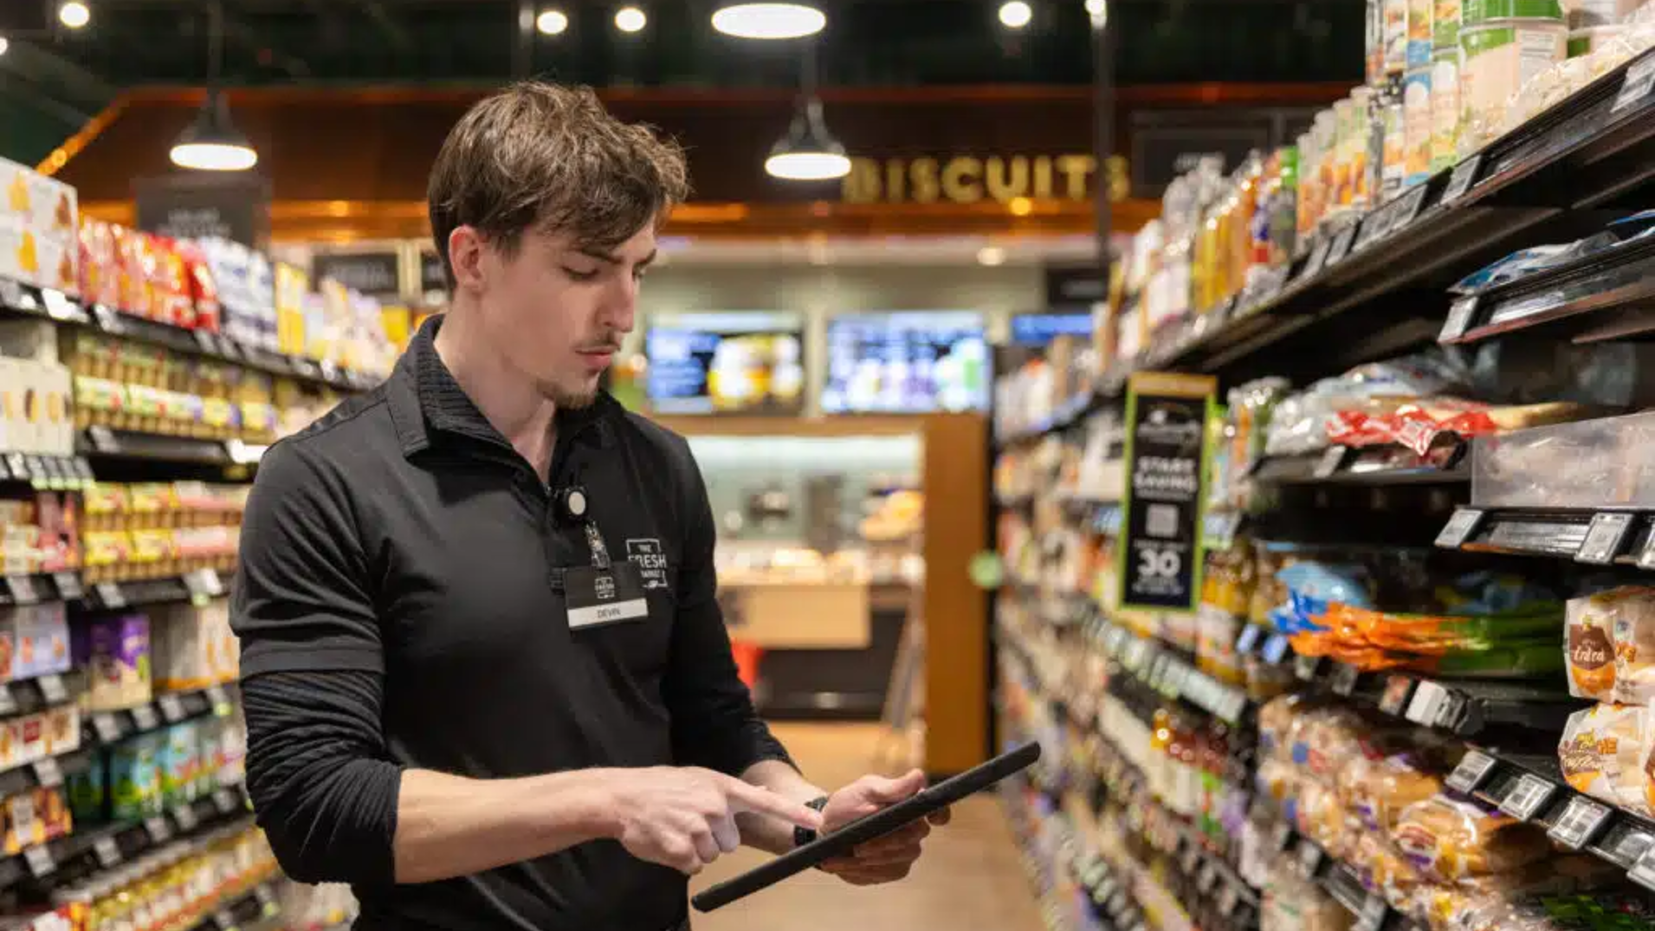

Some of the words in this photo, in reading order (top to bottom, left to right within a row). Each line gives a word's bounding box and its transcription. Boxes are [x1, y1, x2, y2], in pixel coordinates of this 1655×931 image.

[842, 155, 1130, 204] BISCUITS
[1138, 456, 1195, 474] START
[1134, 473, 1197, 492] SAVING
[1137, 548, 1181, 577] 30
[597, 608, 621, 619] DEVIN
